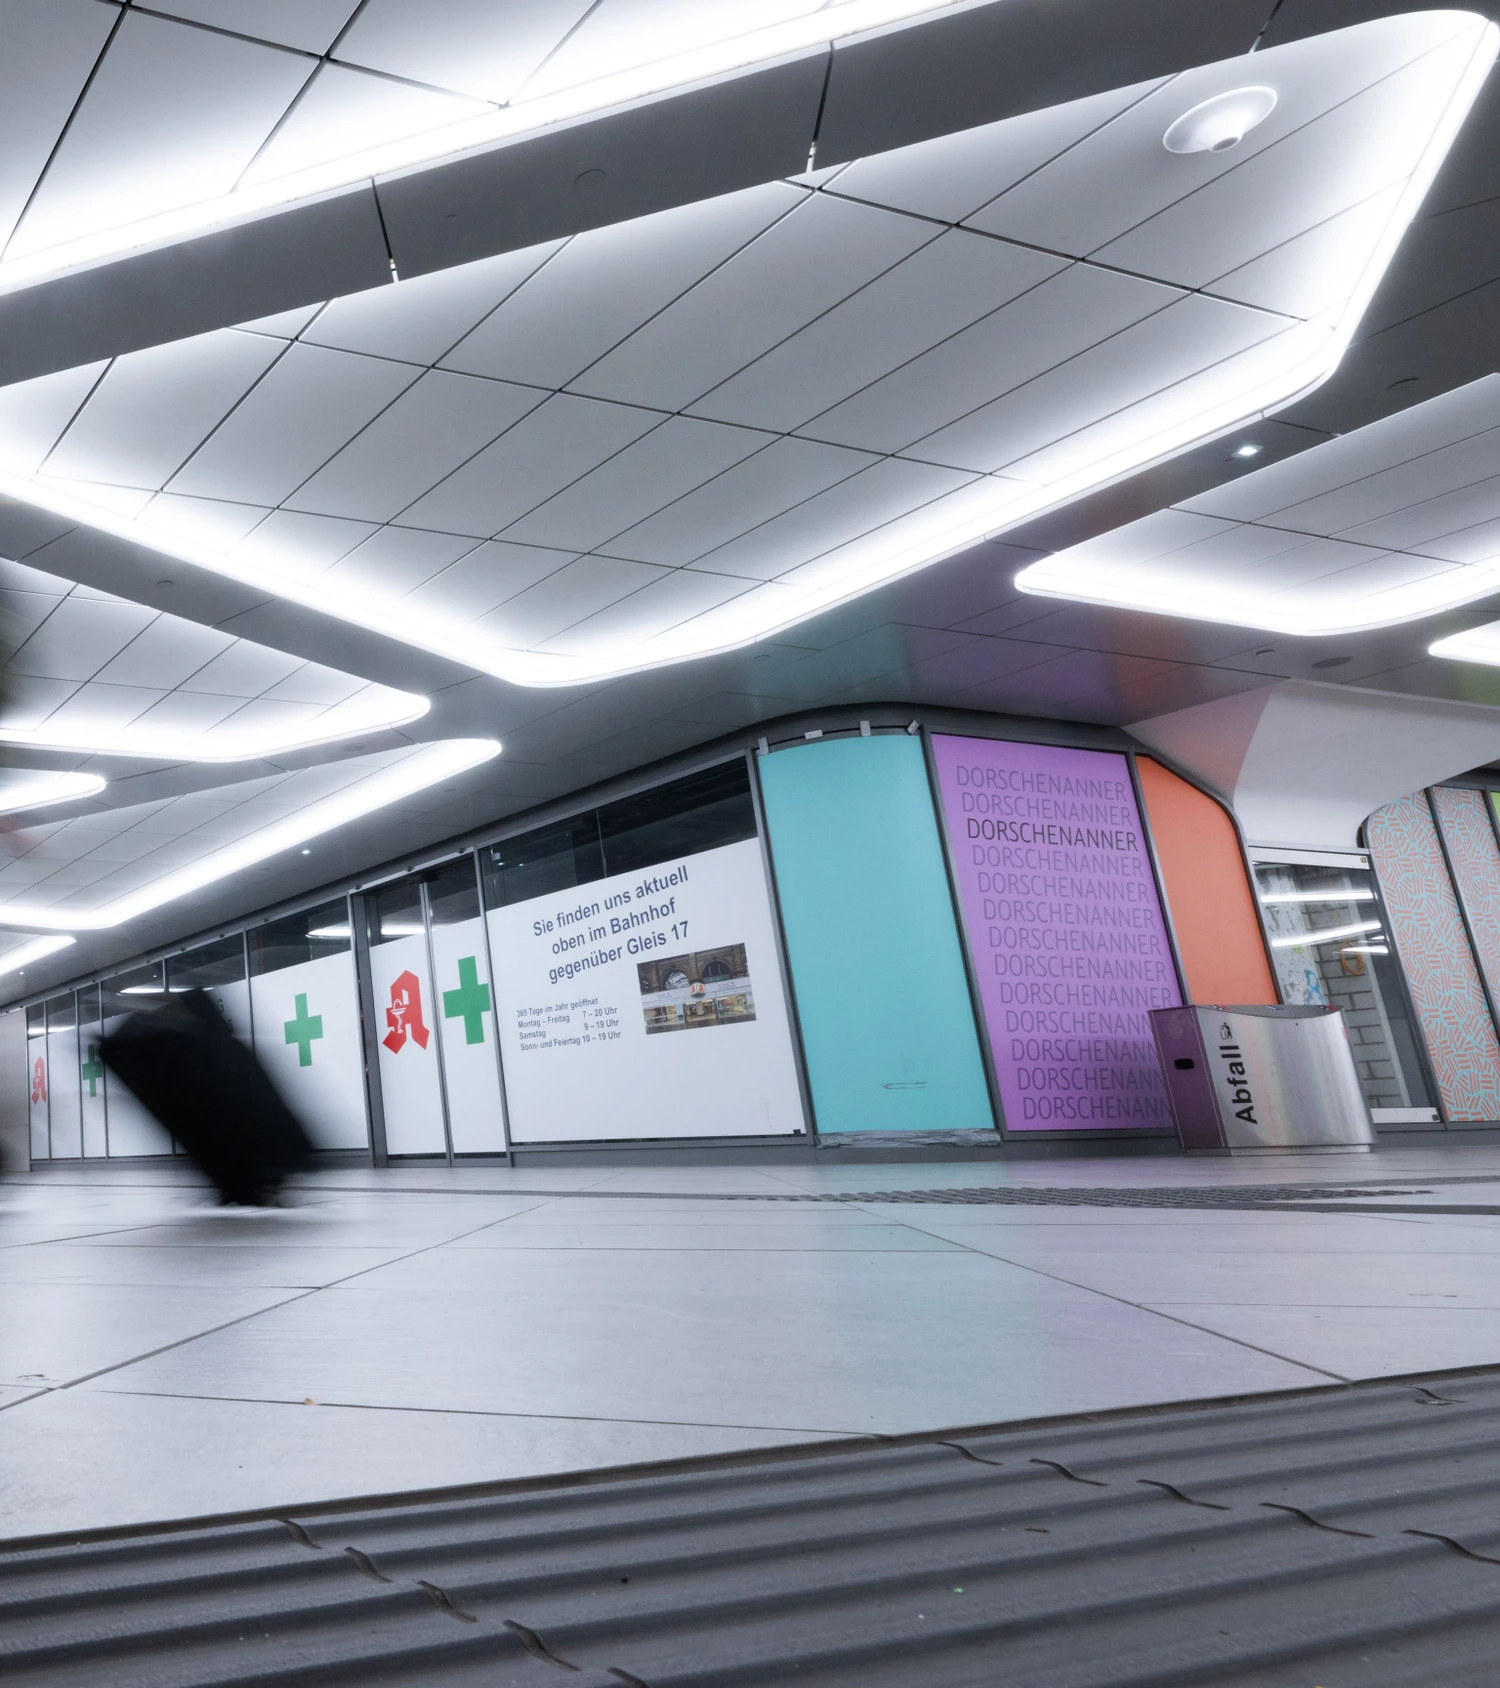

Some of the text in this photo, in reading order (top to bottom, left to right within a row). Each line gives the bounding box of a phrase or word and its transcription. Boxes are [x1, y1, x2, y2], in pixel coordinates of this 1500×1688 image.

[956, 765, 1128, 802] DORSCHENANNER
[961, 791, 1133, 827] DORSCHENANNER
[967, 818, 1139, 853] DORSCHENANNER
[972, 845, 1145, 878] DORSCHENANNER
[533, 865, 689, 937] Sie finden uns aktuell
[978, 871, 1150, 904] DORSCHENANNER
[551, 896, 676, 955] oben im Bahnhof
[983, 898, 1157, 930] DORSCHENANNER
[548, 920, 689, 985] gegenüber Gleis 17
[989, 926, 1162, 956] DORSCHENANNER
[994, 953, 1168, 983] DORSCHENANNER
[516, 1008, 527, 1018] 365
[528, 1007, 543, 1017] Tage
[545, 1005, 553, 1013] im
[554, 1002, 569, 1012] Jahr
[1000, 981, 1174, 1009] DORSCHENANNER
[518, 1018, 541, 1029] Montag
[547, 1014, 570, 1024] Freitag
[582, 1010, 586, 1019] 7
[594, 1008, 603, 1017] 20
[604, 1006, 618, 1016] Uhr
[519, 1030, 547, 1040] Samstag
[583, 1022, 589, 1031] 9
[596, 1020, 605, 1029] 19
[605, 1018, 619, 1028] Uhr
[1005, 1010, 1153, 1035] DORSCHENANN
[520, 1042, 539, 1051] Sonn-
[540, 1039, 553, 1049] und
[554, 1036, 581, 1047] Feiertag
[582, 1034, 591, 1043] 10
[598, 1031, 607, 1041] 19
[607, 1030, 621, 1040] Uhr
[1011, 1038, 1158, 1063] DORSCHENANN
[1017, 1067, 1165, 1091] DORSCHENANN
[1219, 1044, 1258, 1125] Abfall
[1023, 1096, 1173, 1120] DORSCHENANN
